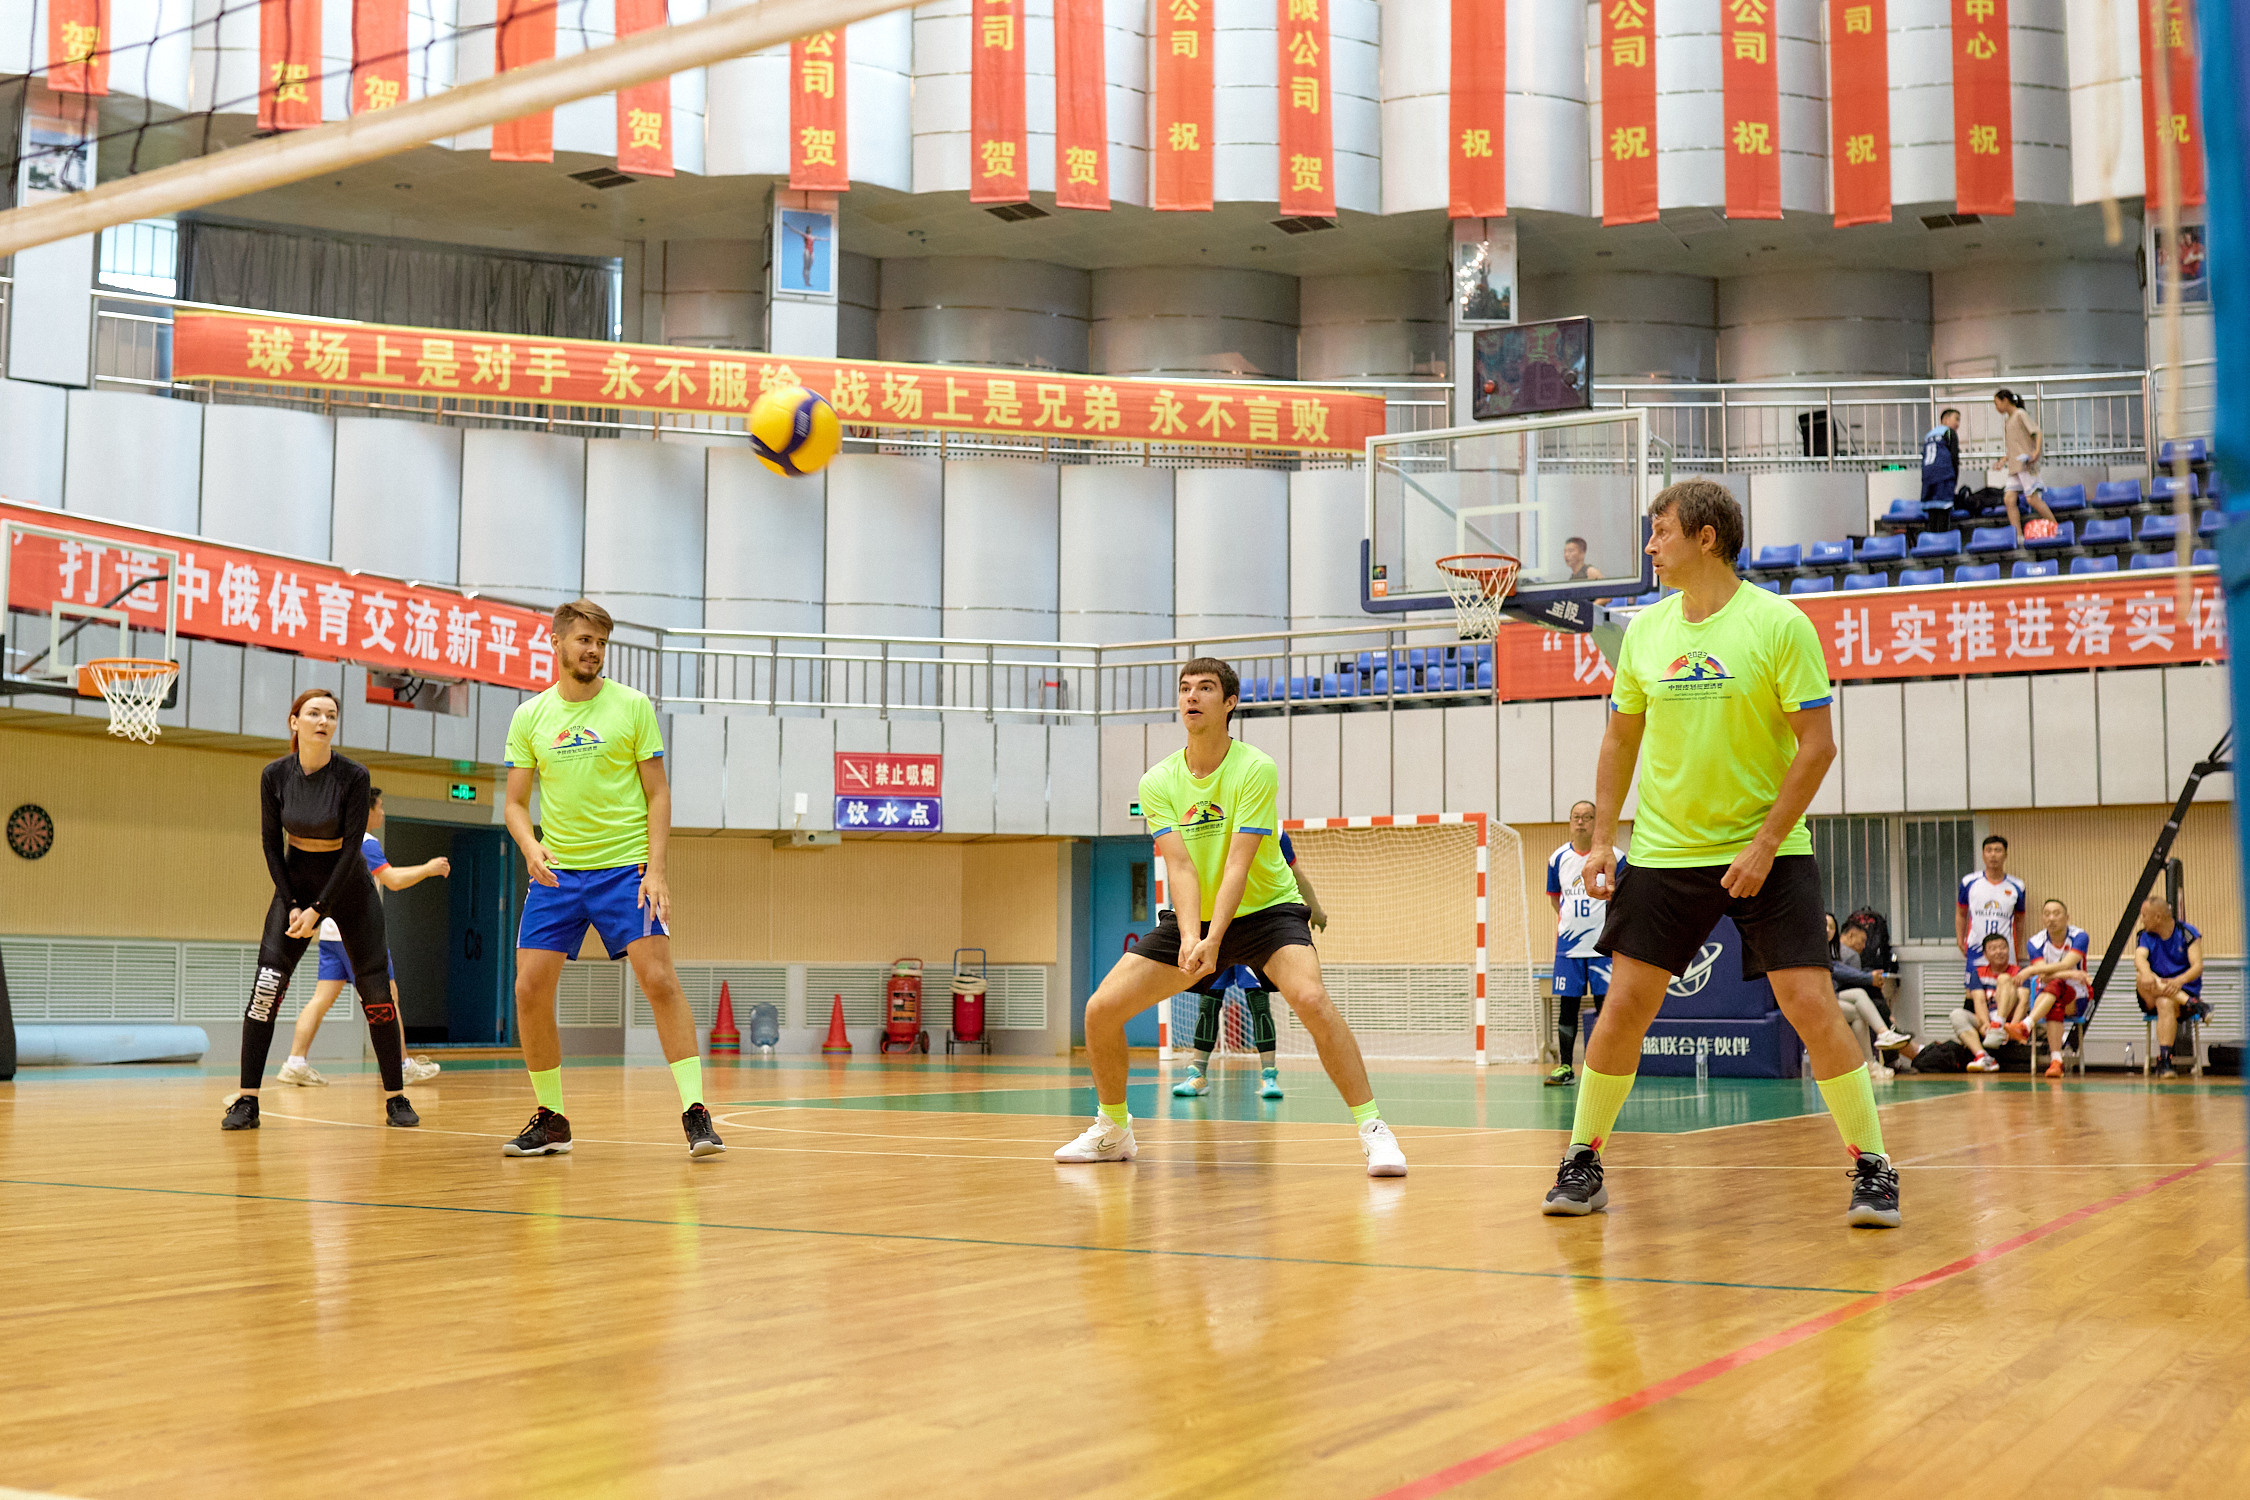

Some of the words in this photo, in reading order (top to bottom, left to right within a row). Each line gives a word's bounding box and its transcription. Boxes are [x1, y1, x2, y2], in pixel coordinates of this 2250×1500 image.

[981, 0, 1015, 51] 司
[1609, 0, 1648, 67] 公司
[1729, 0, 1769, 65] 公司
[1844, 5, 1873, 35] 司
[1966, 0, 1998, 60] 中心
[62, 20, 100, 67] 贺
[271, 60, 309, 104] 贺
[628, 107, 663, 151] 贺
[801, 126, 837, 167] 贺
[1168, 122, 1201, 152] 祝
[1461, 128, 1493, 158] 祝
[1610, 126, 1651, 161] 祝
[1732, 120, 1773, 156] 祝
[1968, 124, 2000, 155] 祝
[981, 140, 1016, 178] 贺
[1066, 146, 1099, 186] 贺
[1846, 133, 1877, 165] 祝
[1290, 153, 1324, 193] 贺
[246, 326, 572, 395] 球场上是对手
[830, 368, 1121, 432] 战场上是兄弟
[1149, 388, 1331, 445] 永不言败
[58, 539, 556, 683] 打造中俄体育交流新平台
[874, 762, 936, 787] 禁止吸烟
[846, 801, 931, 826] 饮水点
[1574, 899, 1590, 918] 16
[1555, 976, 1567, 991] 16
